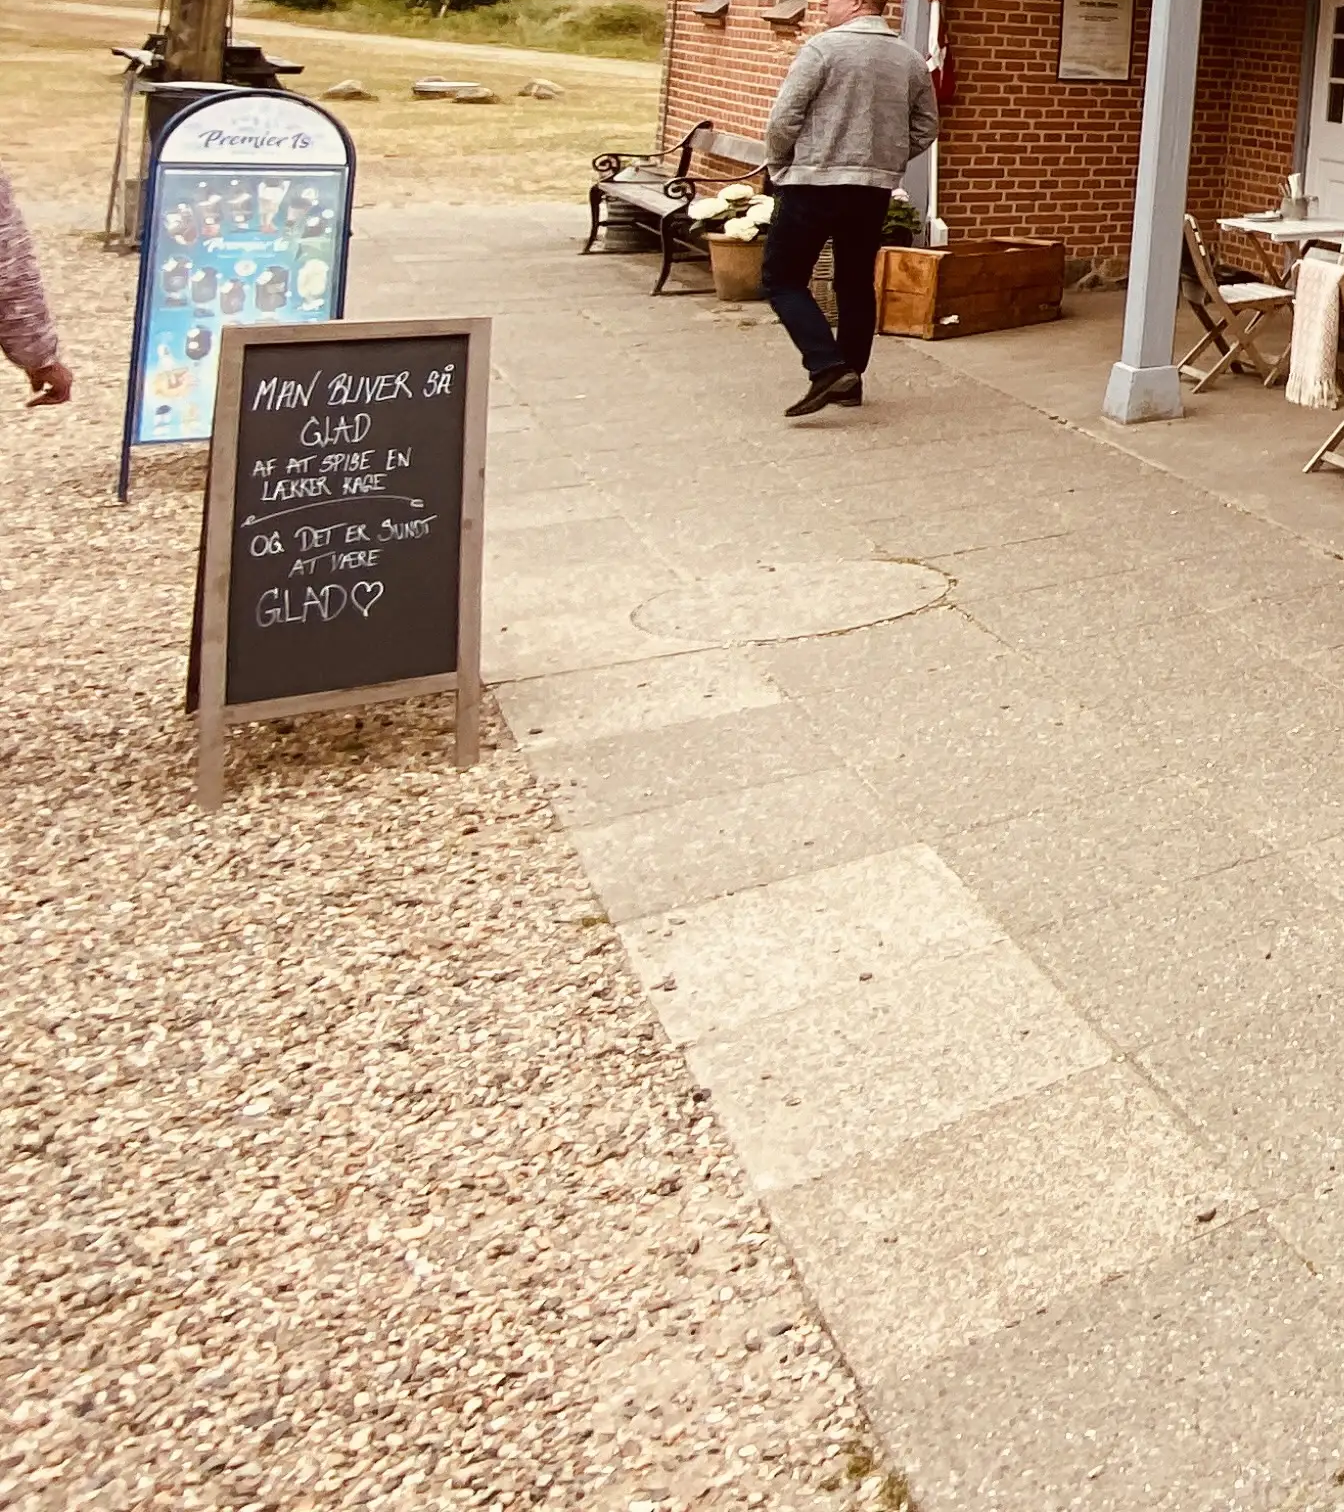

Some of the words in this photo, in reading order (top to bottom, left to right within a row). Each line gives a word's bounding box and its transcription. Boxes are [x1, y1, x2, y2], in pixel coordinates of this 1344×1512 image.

[199, 129, 290, 149] Premier
[251, 370, 323, 411] MAN
[327, 370, 413, 406] BLIVER
[423, 363, 456, 399] SÅ
[300, 412, 372, 448] GLAD
[252, 458, 278, 478] AF
[286, 454, 318, 475] AT
[385, 446, 413, 472] EN
[261, 475, 333, 502] LÆKKER
[341, 473, 389, 497] KAGE
[250, 530, 285, 557] OG
[294, 522, 349, 552] DET
[344, 523, 371, 544] ER
[377, 514, 438, 543] SUNDT
[287, 551, 337, 579] AT
[329, 548, 385, 572] VÆRE
[255, 584, 348, 628] GLAD
